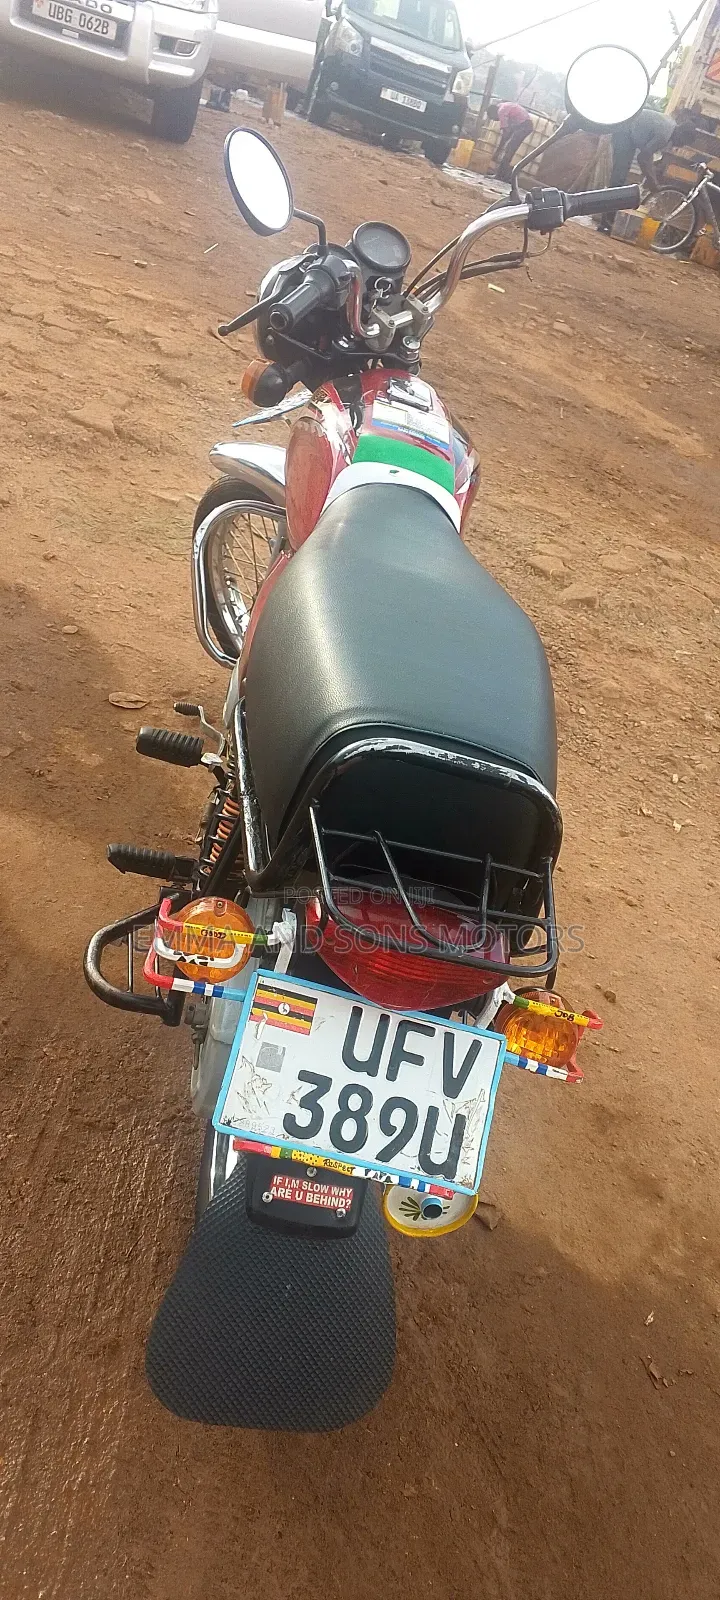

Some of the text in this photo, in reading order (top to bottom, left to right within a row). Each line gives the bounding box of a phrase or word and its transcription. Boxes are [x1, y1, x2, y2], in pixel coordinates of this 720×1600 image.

[48, 2, 109, 35] UBG 062B
[342, 1005, 483, 1099] UFV
[282, 1069, 466, 1180] 389U
[270, 1187, 352, 1209] ARE U BEHIND?
[273, 1175, 284, 1186] IF
[301, 1181, 329, 1194] SLOW
[331, 1186, 353, 1198] WHY
